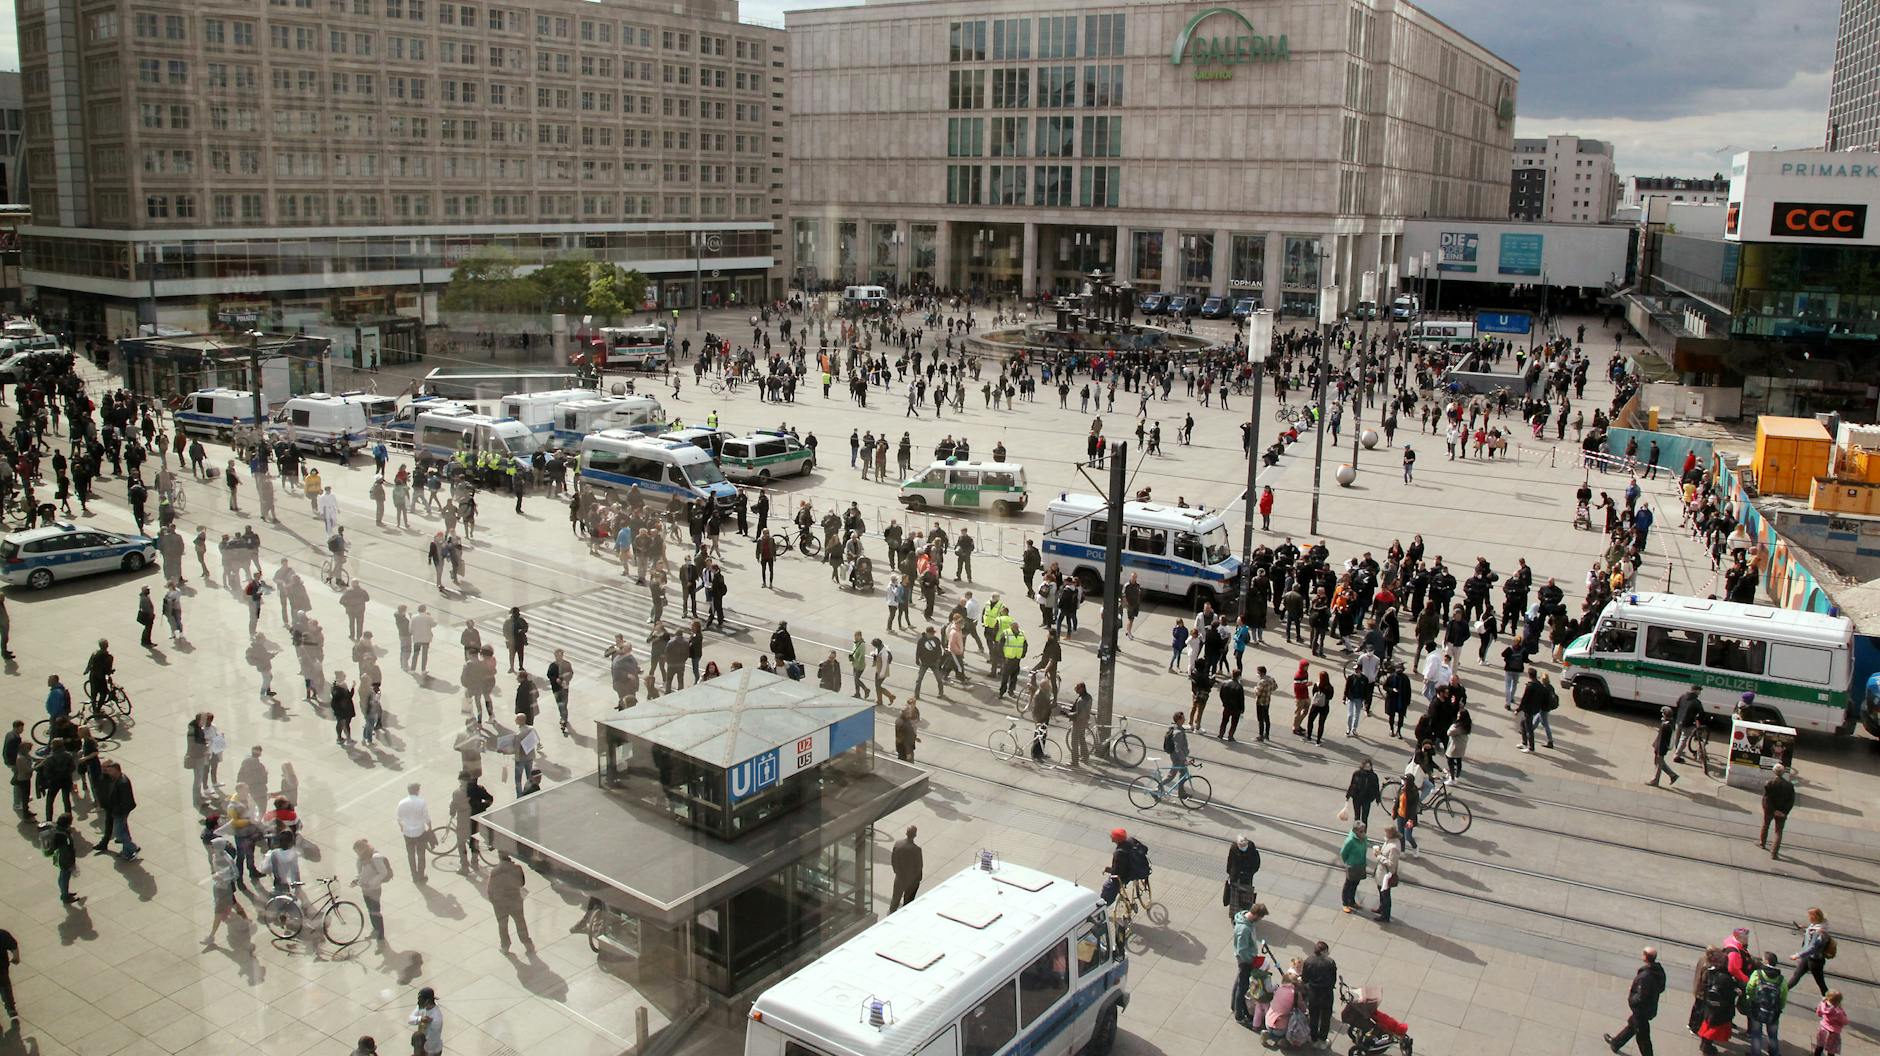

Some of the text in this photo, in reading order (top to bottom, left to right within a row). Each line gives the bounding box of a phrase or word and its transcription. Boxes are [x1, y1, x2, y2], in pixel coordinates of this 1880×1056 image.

[1192, 35, 1291, 65] GALERIA
[1781, 163, 1879, 178] PRIMARK
[1786, 209, 1854, 232] CCC
[1441, 234, 1465, 246] DIE
[1230, 279, 1263, 288] TOPMAN
[1500, 315, 1508, 325] U
[1086, 549, 1106, 560] POLI
[1706, 674, 1759, 692] POLIZEI
[798, 737, 813, 753] U2
[798, 752, 813, 768] U5
[732, 762, 751, 798] U
